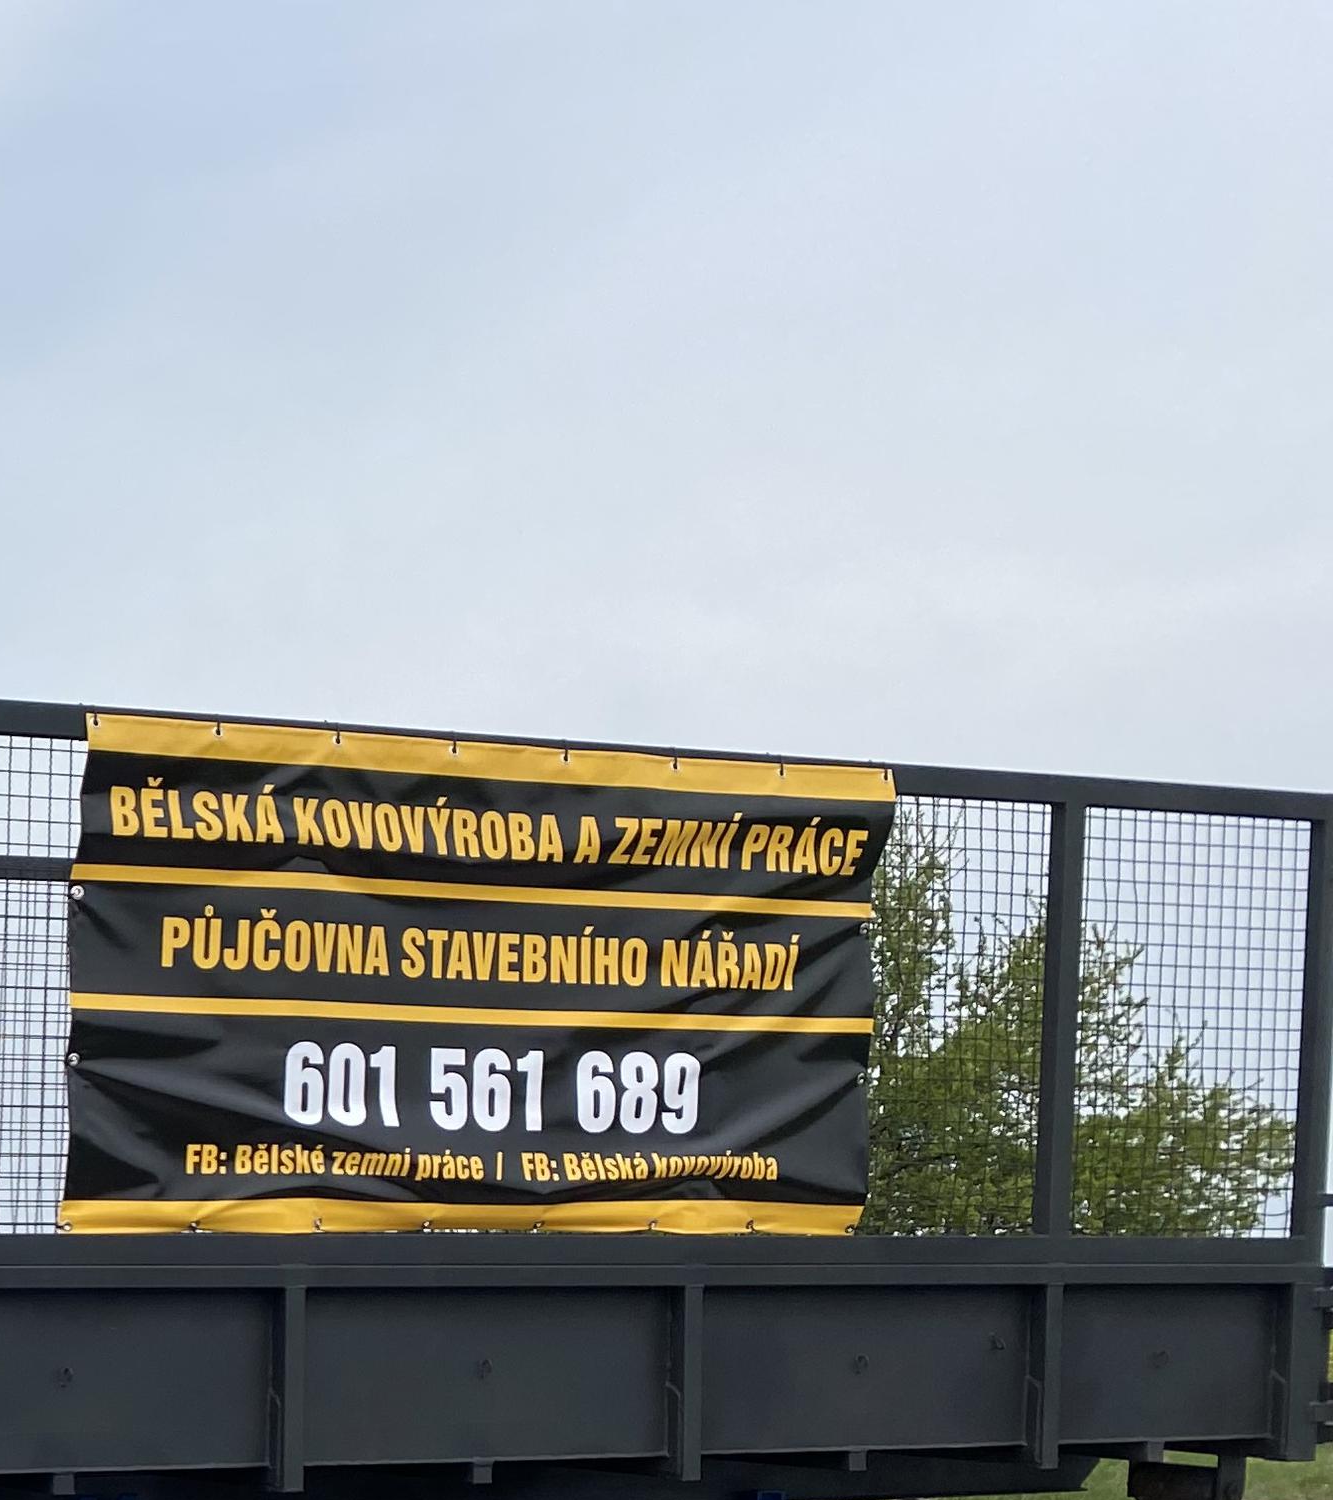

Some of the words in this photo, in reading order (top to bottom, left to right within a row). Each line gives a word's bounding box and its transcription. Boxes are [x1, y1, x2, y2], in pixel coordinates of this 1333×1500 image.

[110, 777, 284, 844] BĚLSKÁ
[293, 796, 564, 863] KOVOVÝROBA
[573, 816, 601, 864] A
[608, 812, 743, 870] ZEMNÍ
[741, 816, 869, 876] PRÁCE
[161, 904, 390, 977] PŮJČOVNA
[400, 925, 648, 987] STAVEBNÍHO
[660, 929, 800, 991] NÁŘADÍ
[284, 1040, 400, 1128] 601
[429, 1047, 544, 1132] 561
[576, 1050, 701, 1134] 689
[186, 1144, 227, 1175] FB:
[235, 1143, 325, 1176] Bělské
[415, 1149, 484, 1181] práce
[521, 1151, 560, 1182] FB:
[563, 1151, 649, 1181] Bělská
[651, 1150, 778, 1182] kovovýroba
